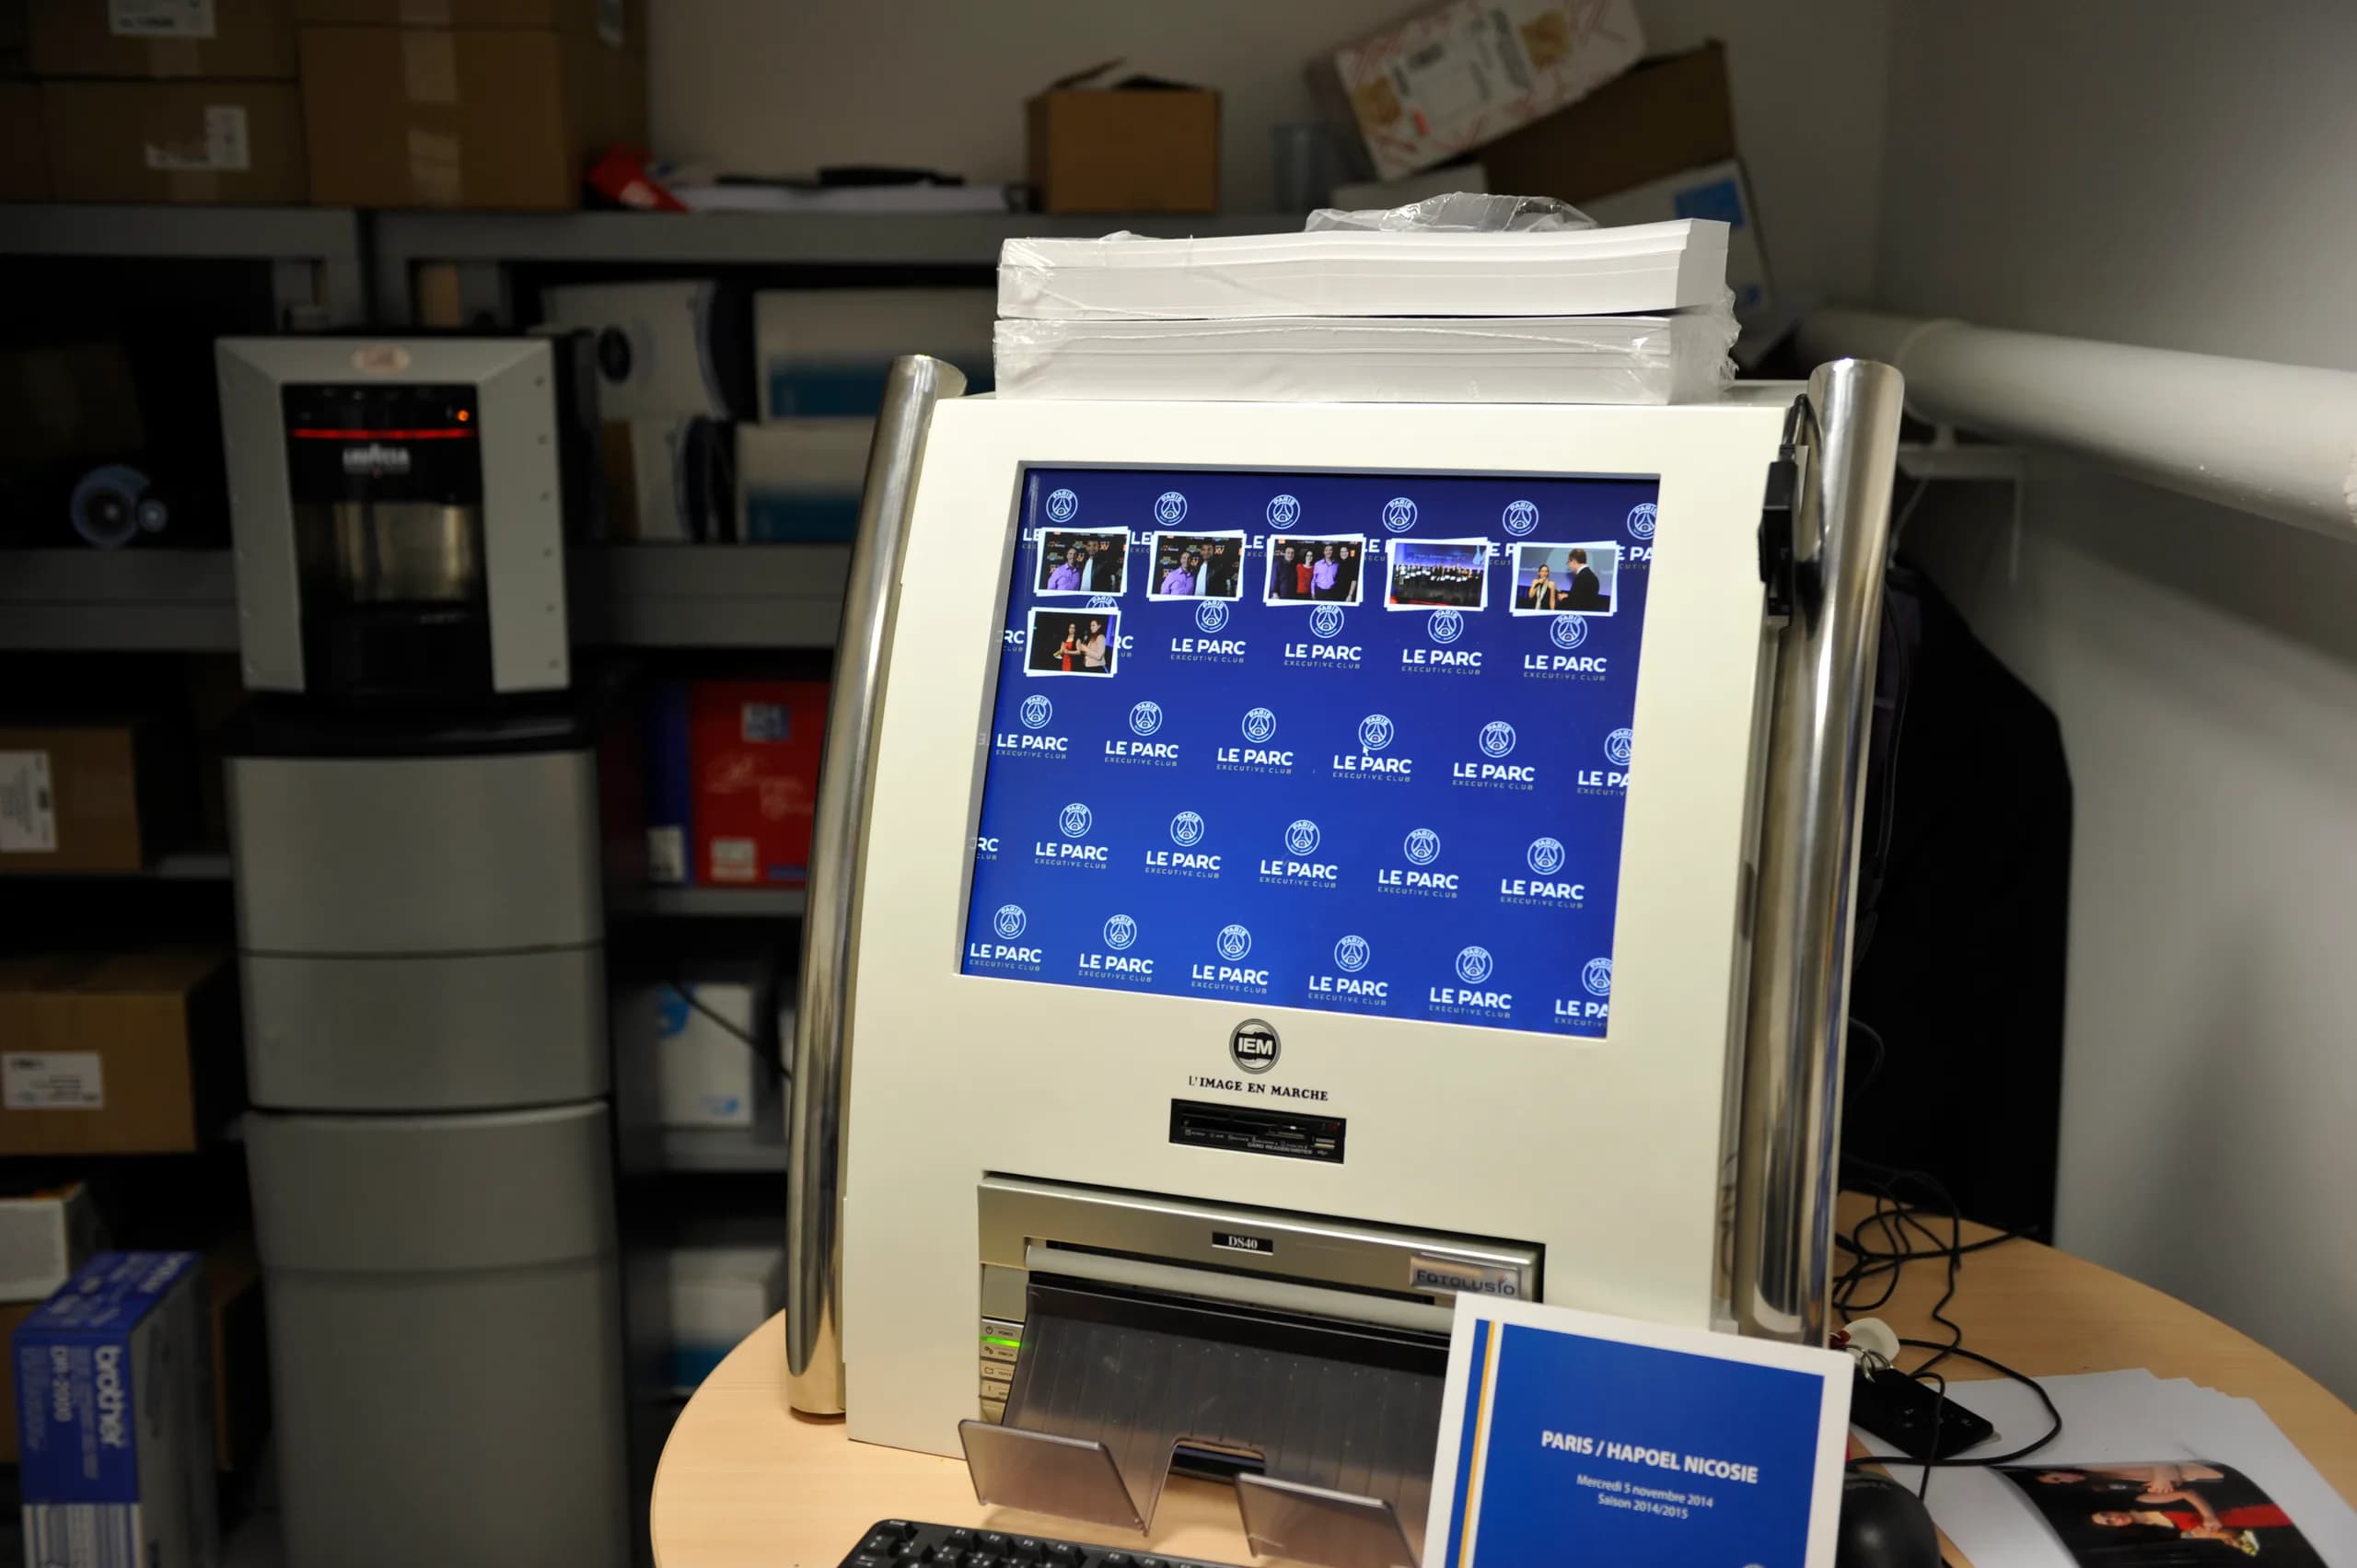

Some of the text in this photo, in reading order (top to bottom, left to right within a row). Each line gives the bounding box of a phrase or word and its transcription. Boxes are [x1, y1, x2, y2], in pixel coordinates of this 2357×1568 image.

[1052, 490, 1073, 499] PARIS
[1161, 493, 1182, 502] PARIS
[1273, 495, 1295, 505] PARIS
[1389, 499, 1411, 508] PARIS
[1510, 502, 1533, 511] PARIS
[1132, 532, 1152, 545] LE
[1630, 547, 1653, 561] PA
[1092, 596, 1113, 605] PARIS
[1202, 600, 1224, 610] PARIS
[1317, 606, 1339, 615] PARIS
[1434, 610, 1457, 620] PARIS
[1558, 615, 1581, 625] PARIS
[1004, 630, 1026, 645] RC
[1171, 638, 1246, 656] LE PARC
[1284, 644, 1362, 661] LE PARC
[1283, 659, 1333, 668] EXECUTIVE
[1402, 649, 1481, 667] LE PARC
[1525, 655, 1607, 672] LE PARC
[1401, 666, 1453, 674] EXECUTIVE
[1524, 671, 1576, 679] EXECUTIVE
[1027, 696, 1048, 705] PARIS
[1136, 703, 1157, 712] PARIS
[1248, 709, 1271, 719] PARIS
[1365, 715, 1388, 726] PARIS
[1486, 723, 1510, 733] PARIS
[1612, 730, 1632, 740] PARI
[996, 734, 1068, 751] LE PARC
[996, 749, 1041, 758] EXECUTIVE
[1106, 740, 1178, 759] LE PARC
[1105, 757, 1152, 765] EXECUTIVE
[1217, 748, 1293, 766] LE PARC
[1216, 764, 1265, 772] EXECUTIVE
[1333, 755, 1411, 773] LE PARC
[1333, 772, 1383, 781] EXECUTIVE
[1453, 762, 1535, 782] LE PARC
[1453, 780, 1504, 789] EXECUTIVE
[1578, 771, 1629, 787] LE PA
[1066, 805, 1086, 814] PARIS
[1178, 812, 1199, 822] PARIS
[1293, 821, 1315, 830] PARIS
[1411, 830, 1434, 840] PARIS
[978, 837, 999, 853] RC
[1535, 839, 1559, 849] PARIS
[1036, 842, 1108, 861] LE PARC
[1035, 858, 1081, 867] EXECUTIVE
[1146, 851, 1221, 870] LE PARC
[1145, 867, 1193, 877] EXECUTIVE
[1260, 860, 1337, 880] LE PARC
[1260, 877, 1336, 889] EXECUTIVE CLUB
[1379, 869, 1458, 889] LE PARC
[1378, 887, 1429, 897] EXECUTIVE
[1501, 878, 1585, 900] LE PARC
[1501, 896, 1583, 909] EXECUTIVE CLUB
[1000, 906, 1021, 915] PARIS
[1110, 916, 1132, 925] PARIS
[1224, 926, 1246, 935] PARIS
[1341, 937, 1364, 947] PARIS
[970, 943, 1042, 963] LE PARC
[1463, 947, 1487, 958] PARIS
[970, 959, 1015, 970] EXECUTIVE
[1079, 953, 1153, 974] LE PARC
[1079, 970, 1152, 982] EXECUTIVE CLUB
[1192, 965, 1269, 985] LE PARC
[1191, 981, 1241, 993] EXECUTIVE
[1309, 975, 1388, 997] LE PARC
[1308, 993, 1387, 1005] EXECUTIVE CLUB
[1430, 987, 1512, 1010] LE PARC
[1429, 1005, 1510, 1018] EXECUTIVE CLUB
[1555, 999, 1608, 1018] LE PA
[1555, 1016, 1605, 1027] EXECUTIV
[1238, 1038, 1273, 1055] IEM
[1189, 1075, 1329, 1101] L'IMAGE EN MARCHE
[1228, 1236, 1258, 1249] DS40
[95, 1345, 125, 1448] brother
[1541, 1430, 1759, 1483] PARIS / HAPOEL NICOSIE
[1577, 1473, 1713, 1508] Mercredi 5 novembre 2014
[1597, 1493, 1689, 1519] Saison 2014/2015
